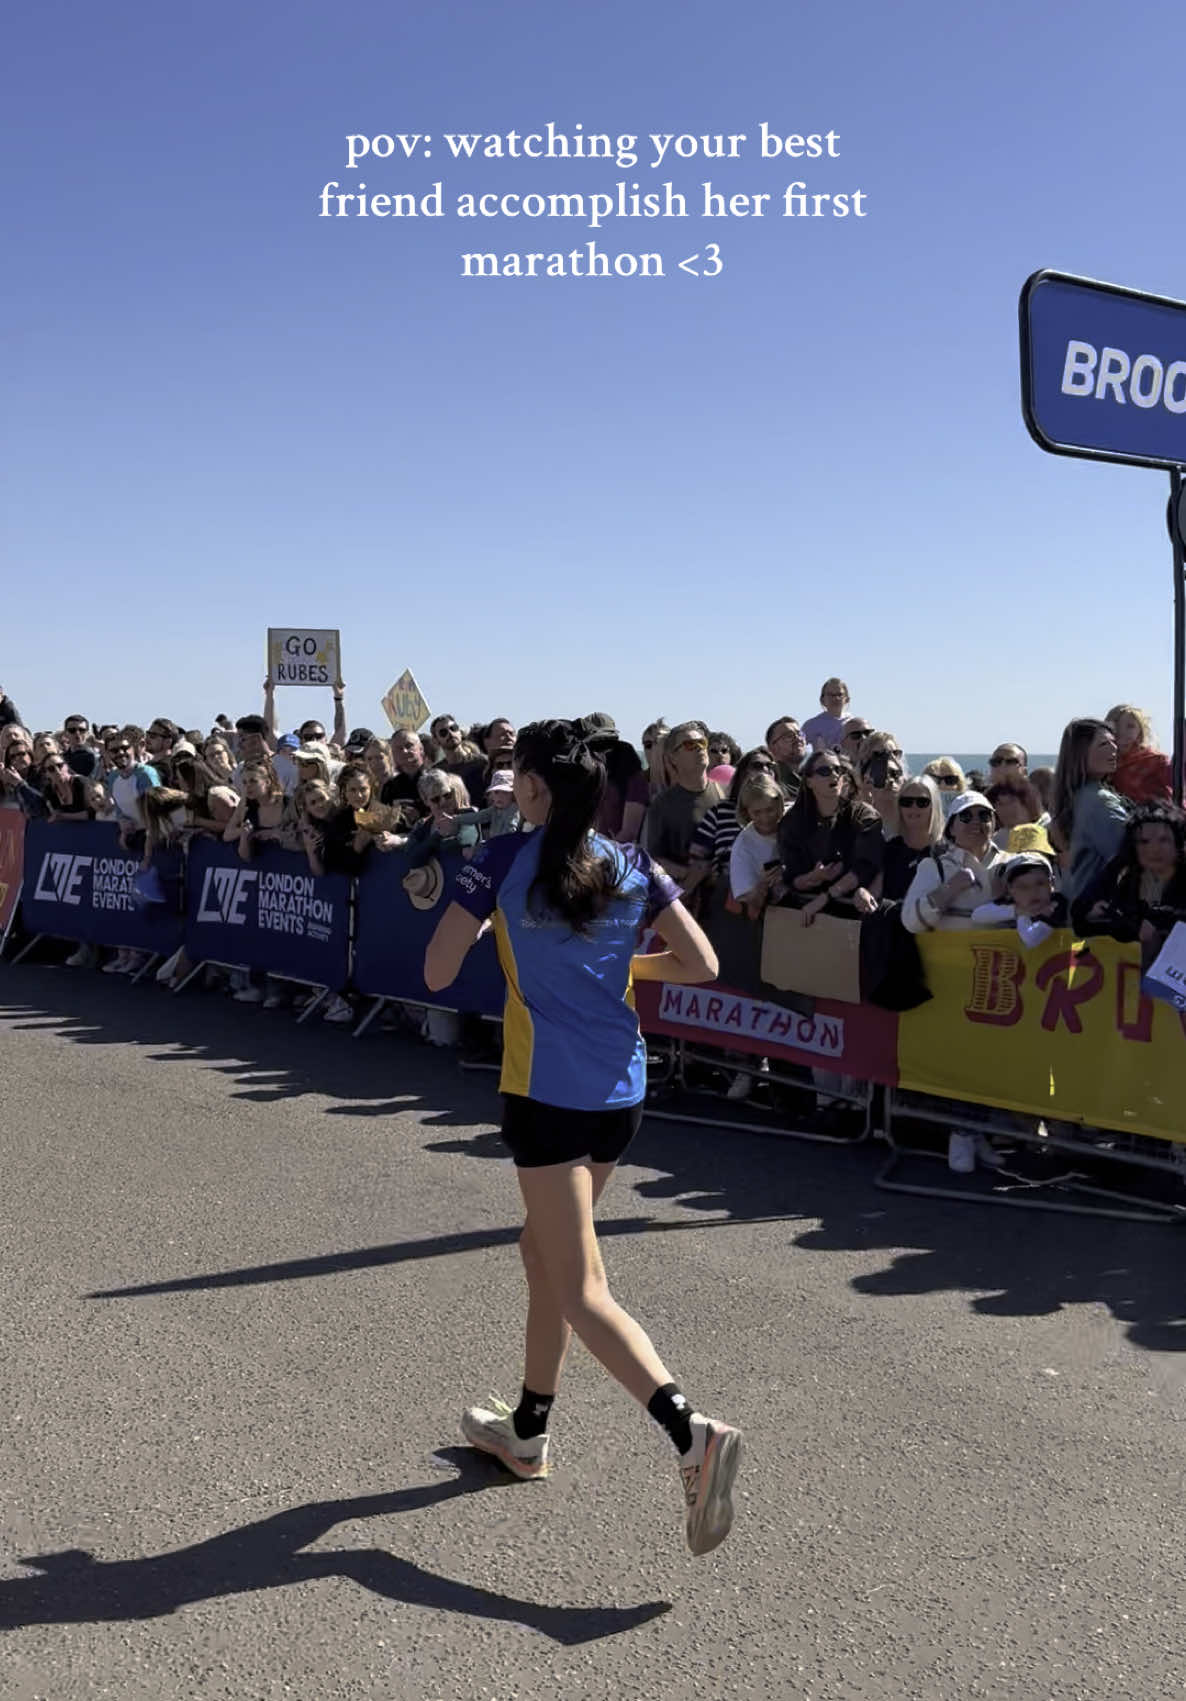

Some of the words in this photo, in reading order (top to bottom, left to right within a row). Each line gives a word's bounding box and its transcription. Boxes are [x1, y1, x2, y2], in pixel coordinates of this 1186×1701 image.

[285, 635, 317, 656] GO
[278, 663, 329, 682] RUBES
[92, 875, 135, 894] MARAT
[258, 871, 315, 898] LONDON
[258, 890, 333, 923] MARATHON
[258, 909, 305, 935] EVENTS
[663, 990, 839, 1049] MARATHON
